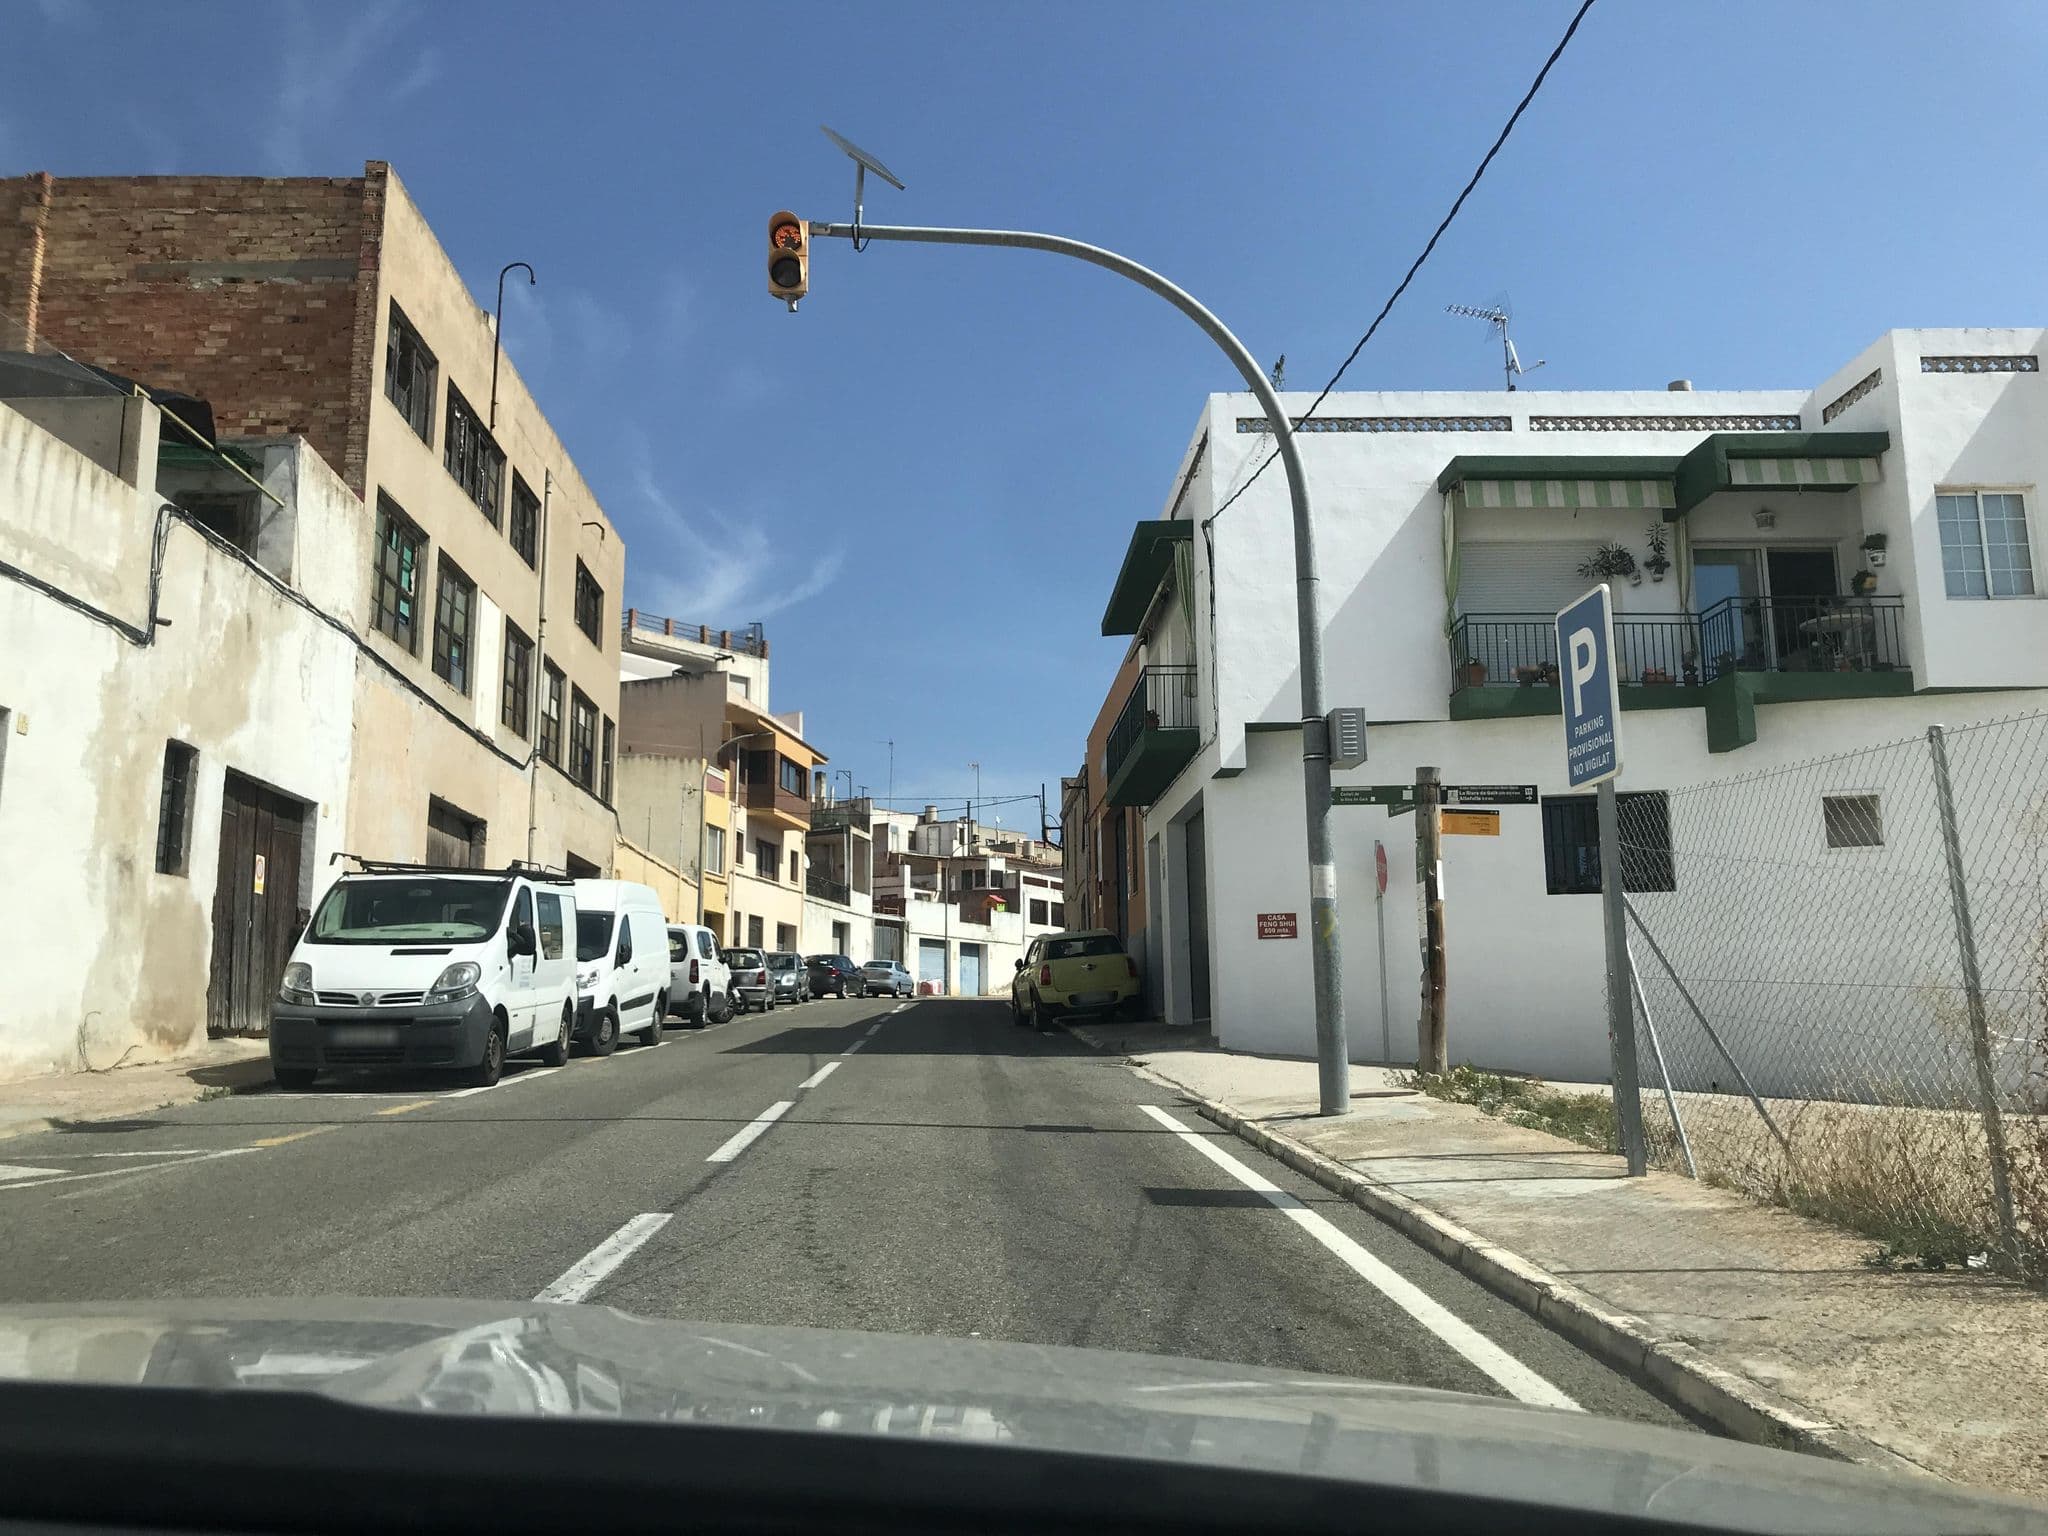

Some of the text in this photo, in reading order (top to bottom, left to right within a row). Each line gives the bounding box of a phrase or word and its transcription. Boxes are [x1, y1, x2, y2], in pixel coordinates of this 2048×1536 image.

[1568, 626, 1597, 718] P
[1574, 714, 1604, 739] PARKING
[1568, 732, 1613, 761] PROVISIONAL
[1573, 751, 1611, 777] NO VIGILAT
